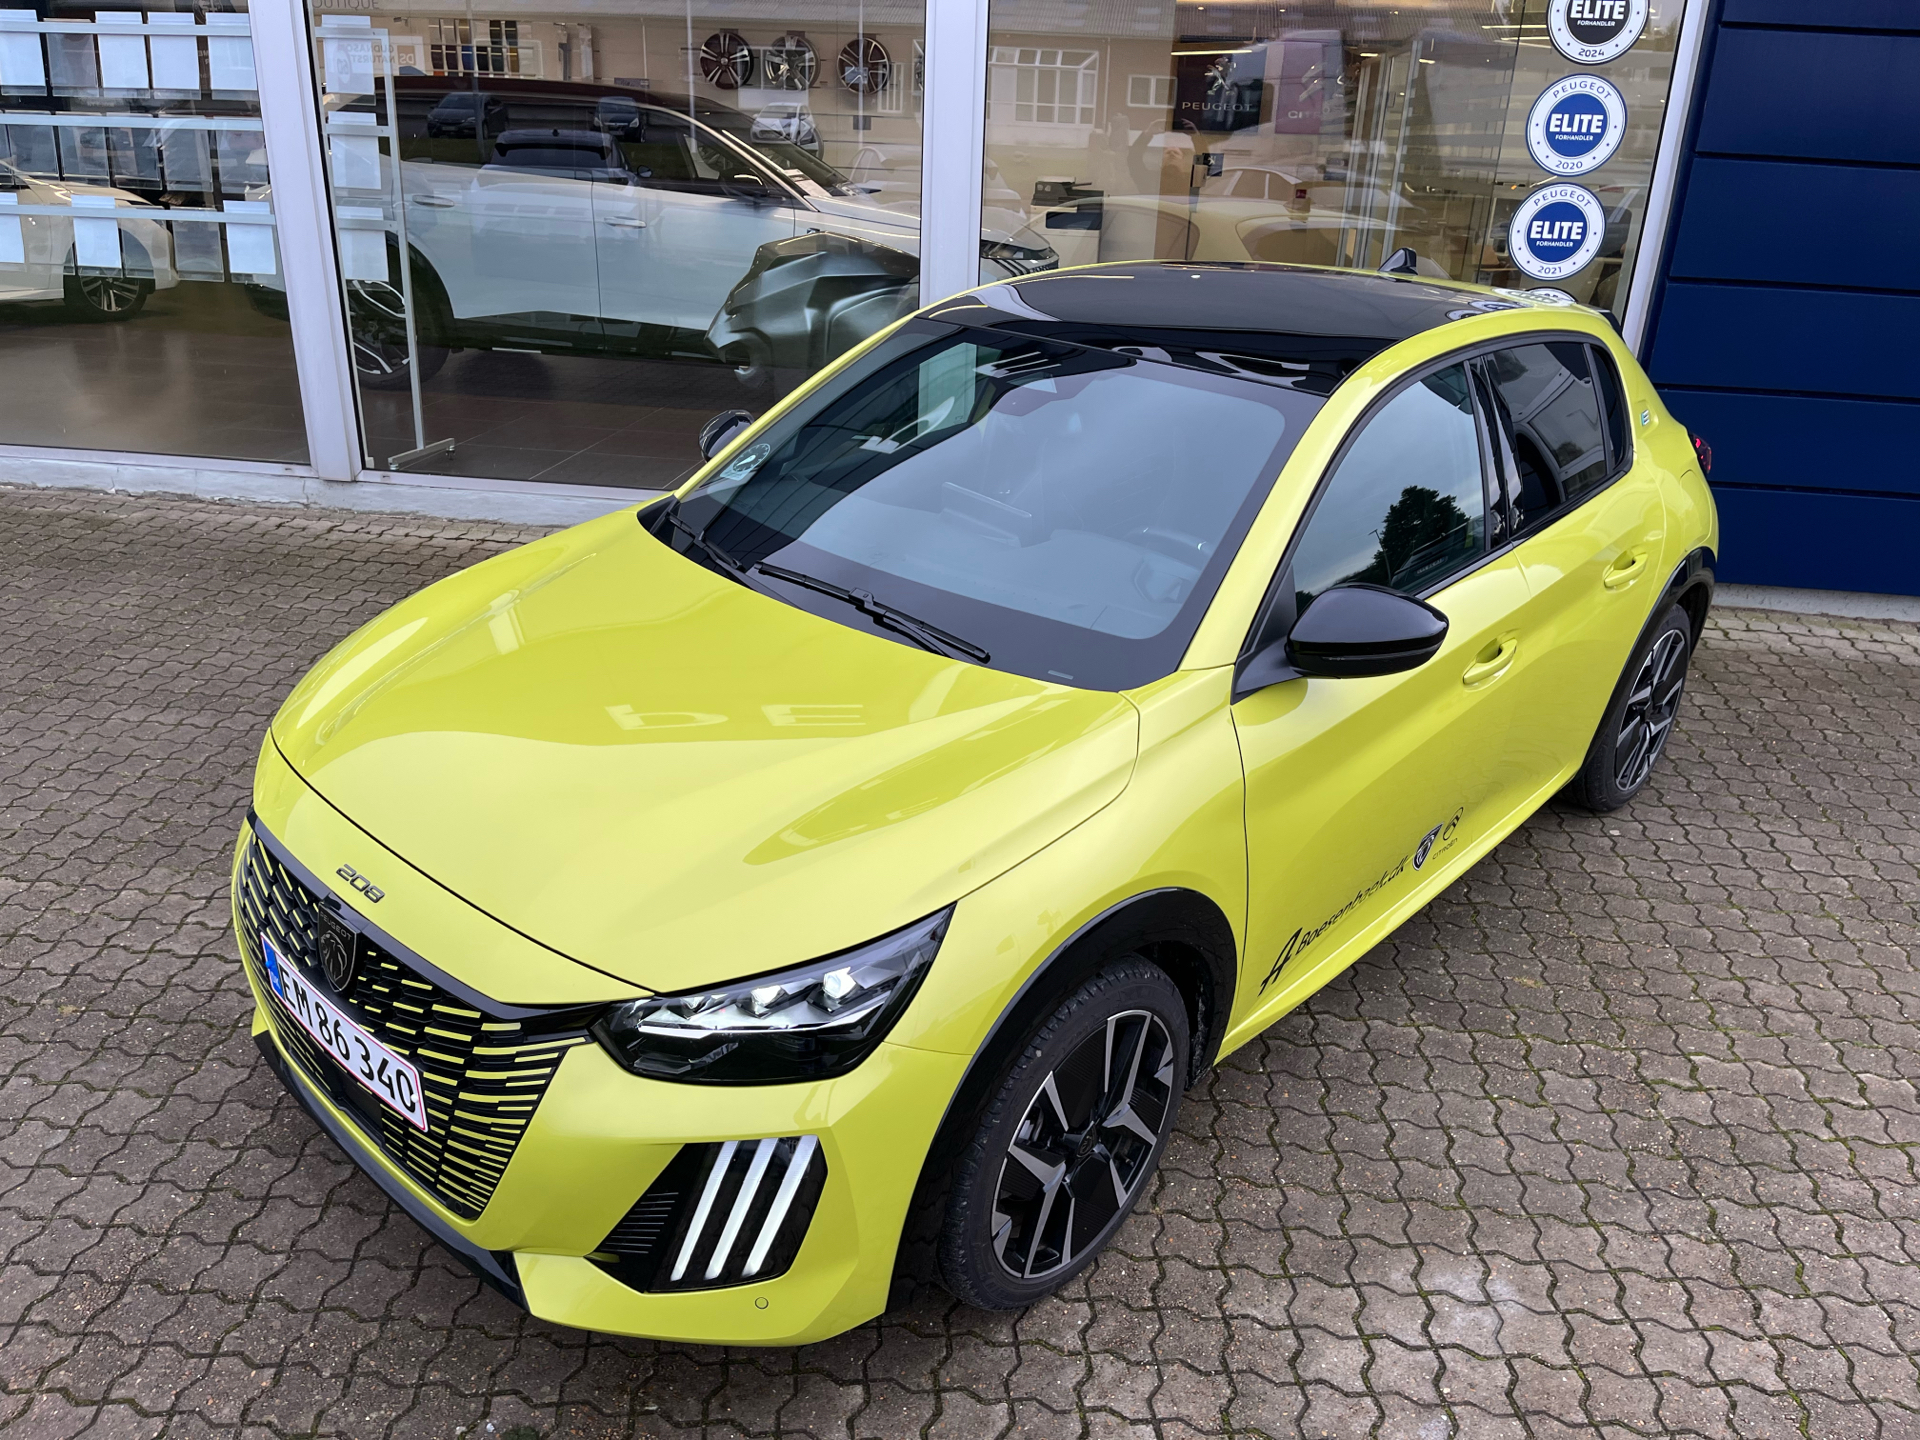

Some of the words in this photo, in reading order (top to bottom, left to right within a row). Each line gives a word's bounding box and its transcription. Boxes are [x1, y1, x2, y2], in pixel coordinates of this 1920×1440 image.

[312, 0, 380, 10] OUTIQUE
[1570, 0, 1626, 20] ELITE
[1578, 48, 1605, 58] 2024
[1552, 80, 1612, 99] PEUGEOT
[1182, 101, 1253, 111] PEUGEOT
[1549, 113, 1604, 133] ELITE
[1555, 160, 1583, 170] 2020
[1533, 189, 1592, 207] PEUGEOT
[1530, 220, 1584, 240] ELITE
[1537, 265, 1562, 275] 2021
[336, 863, 386, 903] 208
[320, 911, 352, 940] PEUGEOT
[280, 967, 314, 1028] EM
[316, 1001, 350, 1061] 86
[355, 1035, 416, 1113] 340
